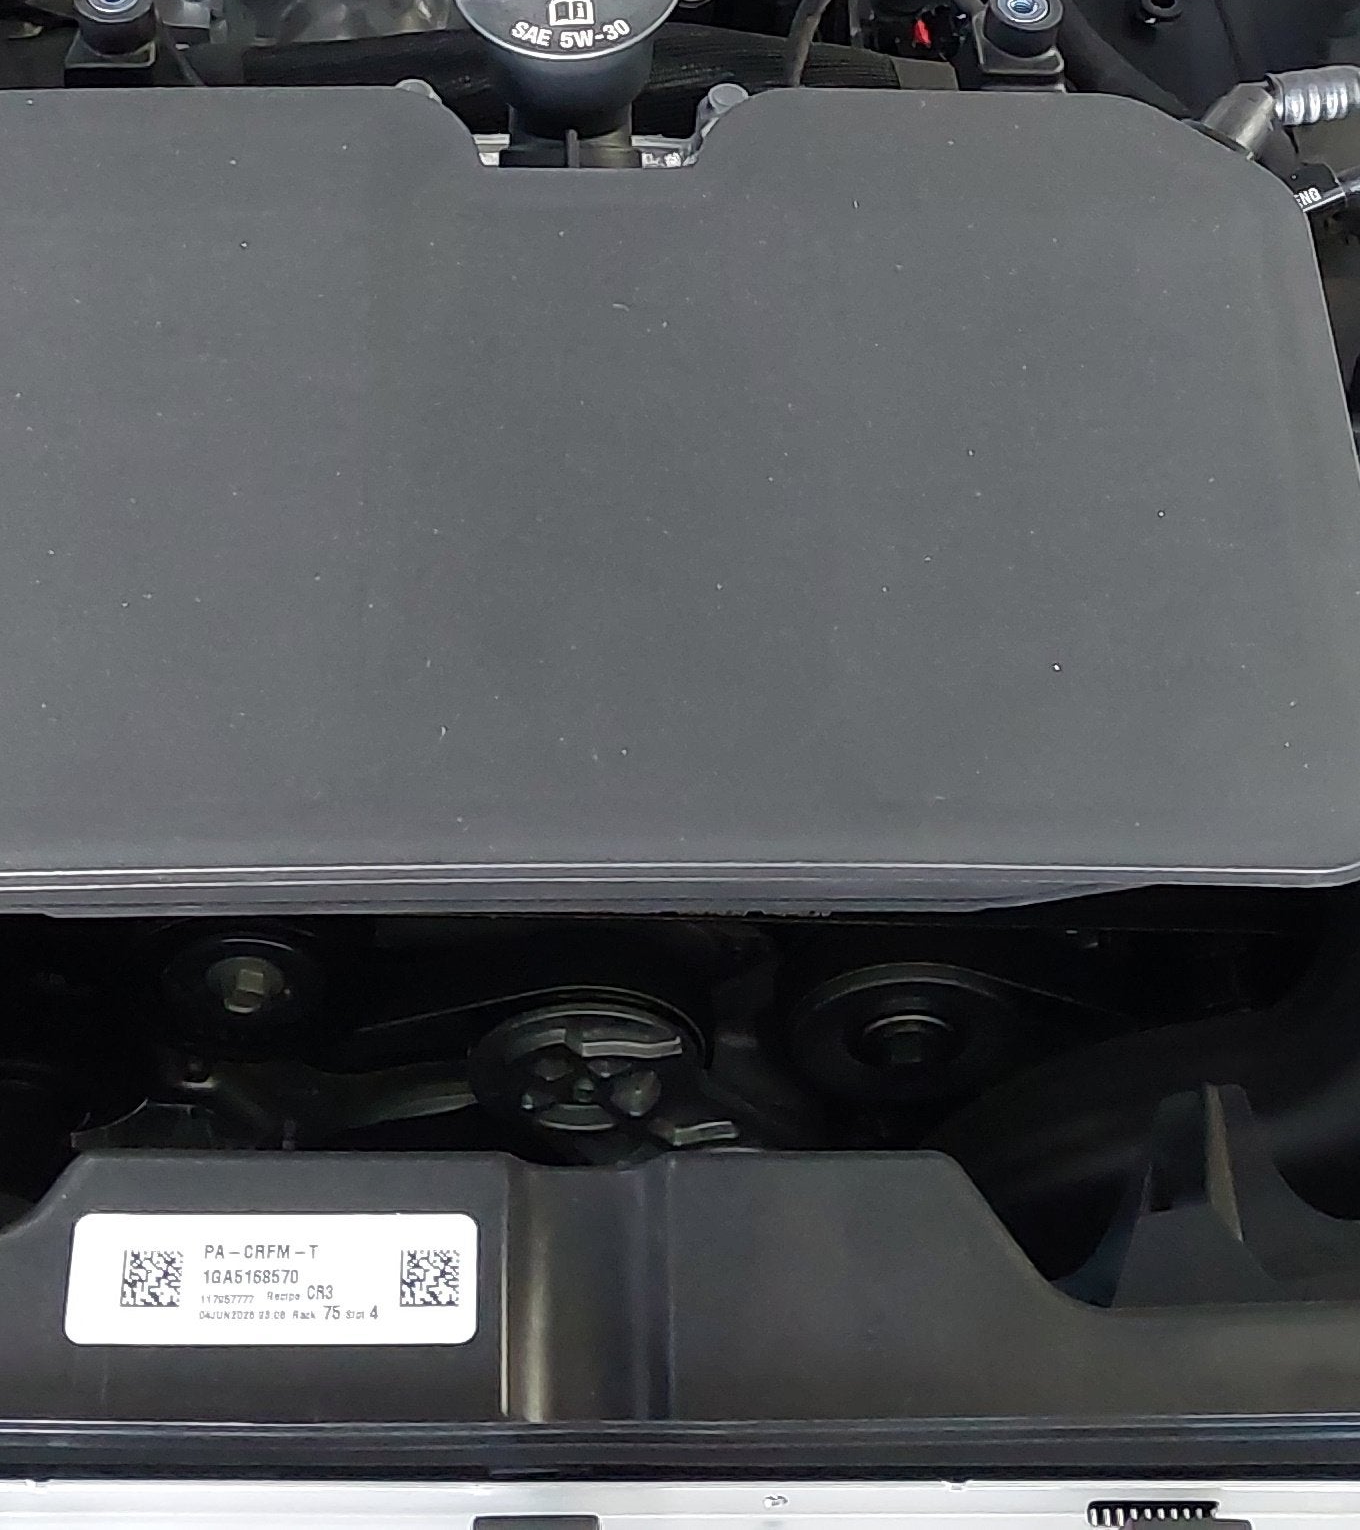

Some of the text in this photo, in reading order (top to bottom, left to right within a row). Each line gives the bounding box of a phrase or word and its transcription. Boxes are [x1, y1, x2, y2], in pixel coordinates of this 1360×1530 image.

[510, 19, 631, 49] SAE 5W-30
[307, 1284, 334, 1300] CR3
[322, 1305, 341, 1320] 75
[369, 1304, 379, 1320] 4
